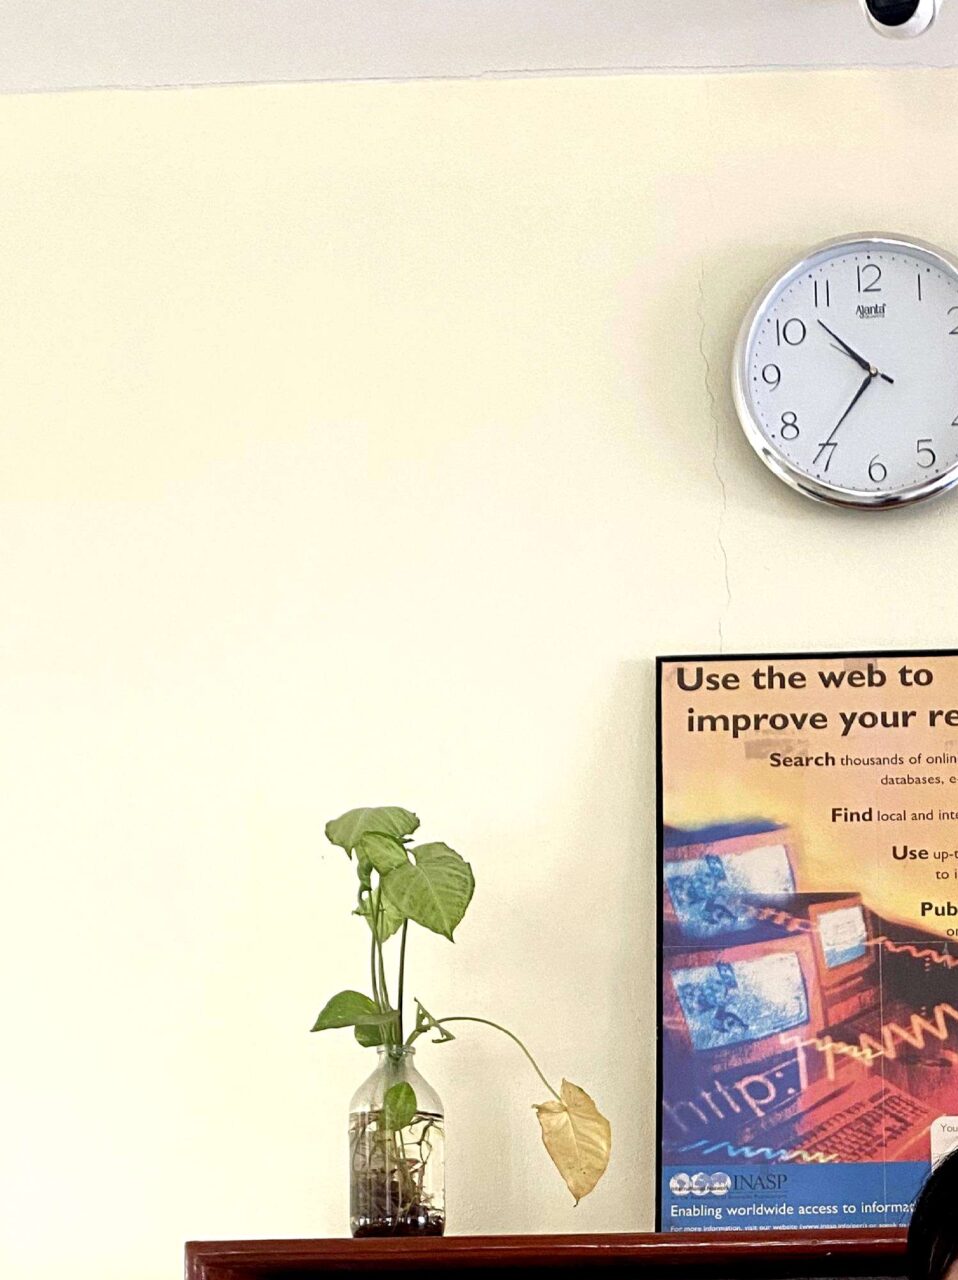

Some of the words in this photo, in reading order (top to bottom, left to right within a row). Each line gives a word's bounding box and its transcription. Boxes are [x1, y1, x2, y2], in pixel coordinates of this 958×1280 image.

[857, 264, 882, 292] 12
[815, 280, 830, 307] 11
[776, 318, 806, 346] 10
[761, 364, 781, 392] 9
[780, 411, 800, 440] 8
[818, 443, 838, 472] 7
[917, 439, 936, 468] 5
[868, 454, 887, 483] 6
[676, 667, 740, 691] Use
[753, 666, 807, 689] the
[818, 664, 886, 688] web
[899, 664, 934, 686] to
[687, 708, 828, 738] improve
[840, 709, 916, 735] your
[770, 751, 835, 768] Search
[841, 754, 904, 766] thousands
[909, 753, 922, 765] of
[880, 773, 945, 786] databases,
[831, 807, 873, 823] Find
[877, 810, 906, 821] local
[911, 809, 934, 820] and
[892, 846, 929, 861] Use
[936, 869, 950, 880] to
[734, 1174, 787, 1190] INASP
[671, 1204, 722, 1219] Enabling
[727, 1203, 794, 1216] worldwide
[798, 1204, 838, 1215] access
[843, 1204, 857, 1214] to
